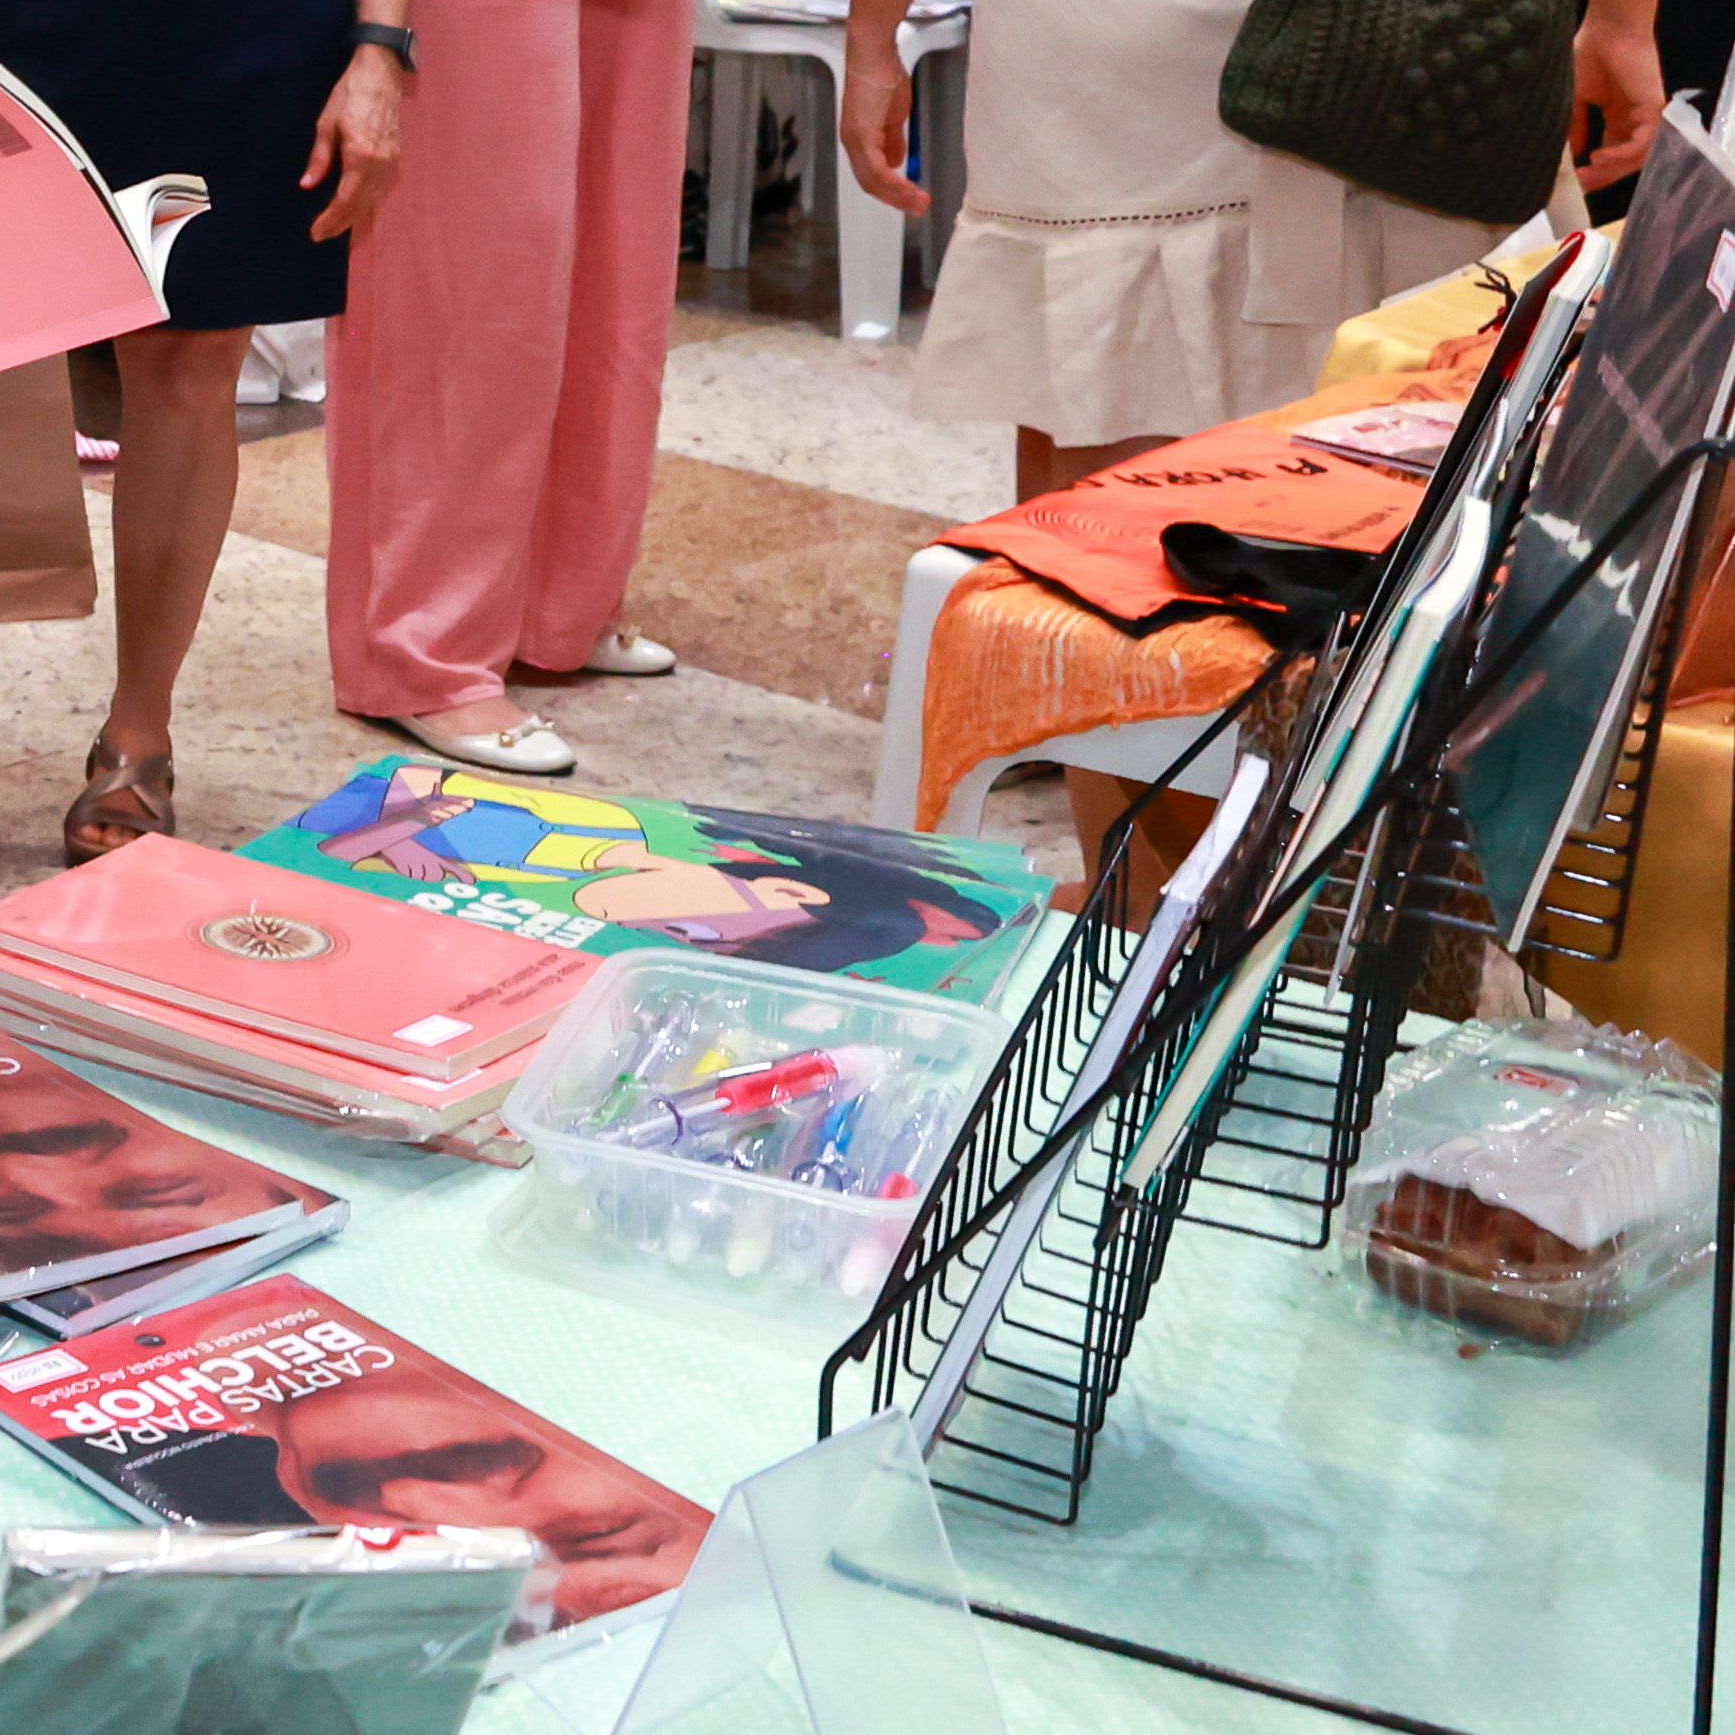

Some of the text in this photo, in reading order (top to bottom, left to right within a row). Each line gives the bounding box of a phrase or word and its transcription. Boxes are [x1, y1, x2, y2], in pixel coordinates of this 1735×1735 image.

[282, 1307, 320, 1328] PARA
[50, 1321, 366, 1436] BELCHIOR
[126, 1345, 200, 1375] MUDAR
[220, 1344, 396, 1413] CARTAS
[29, 1379, 102, 1406] COISAS
[85, 1400, 226, 1455] PARA
